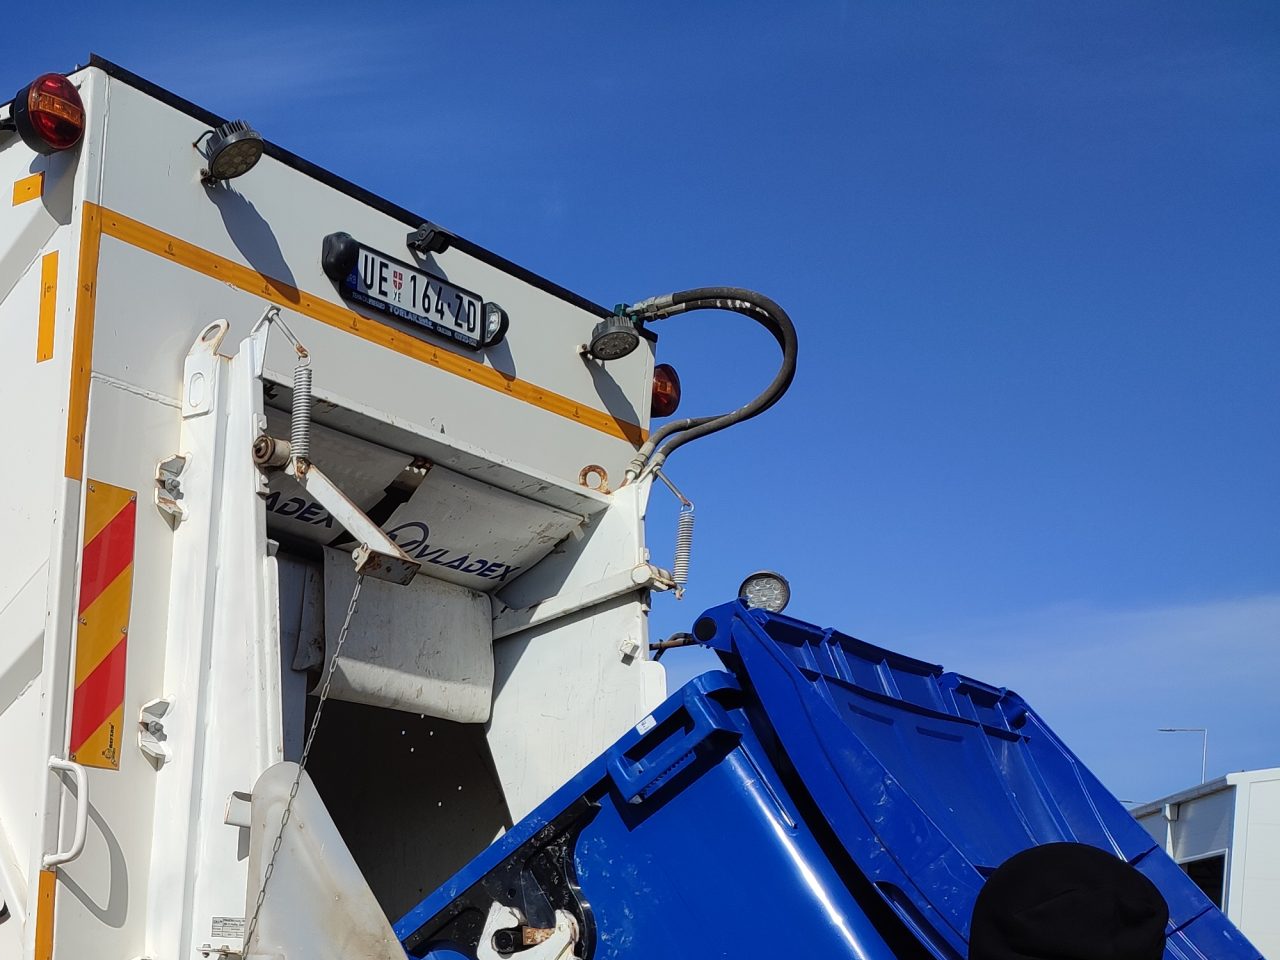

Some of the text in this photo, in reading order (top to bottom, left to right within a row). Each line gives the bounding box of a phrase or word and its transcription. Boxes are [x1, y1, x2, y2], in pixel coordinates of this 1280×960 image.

[364, 254, 389, 297] UE
[266, 491, 335, 529] ADEX
[415, 544, 521, 582] VLADEX
